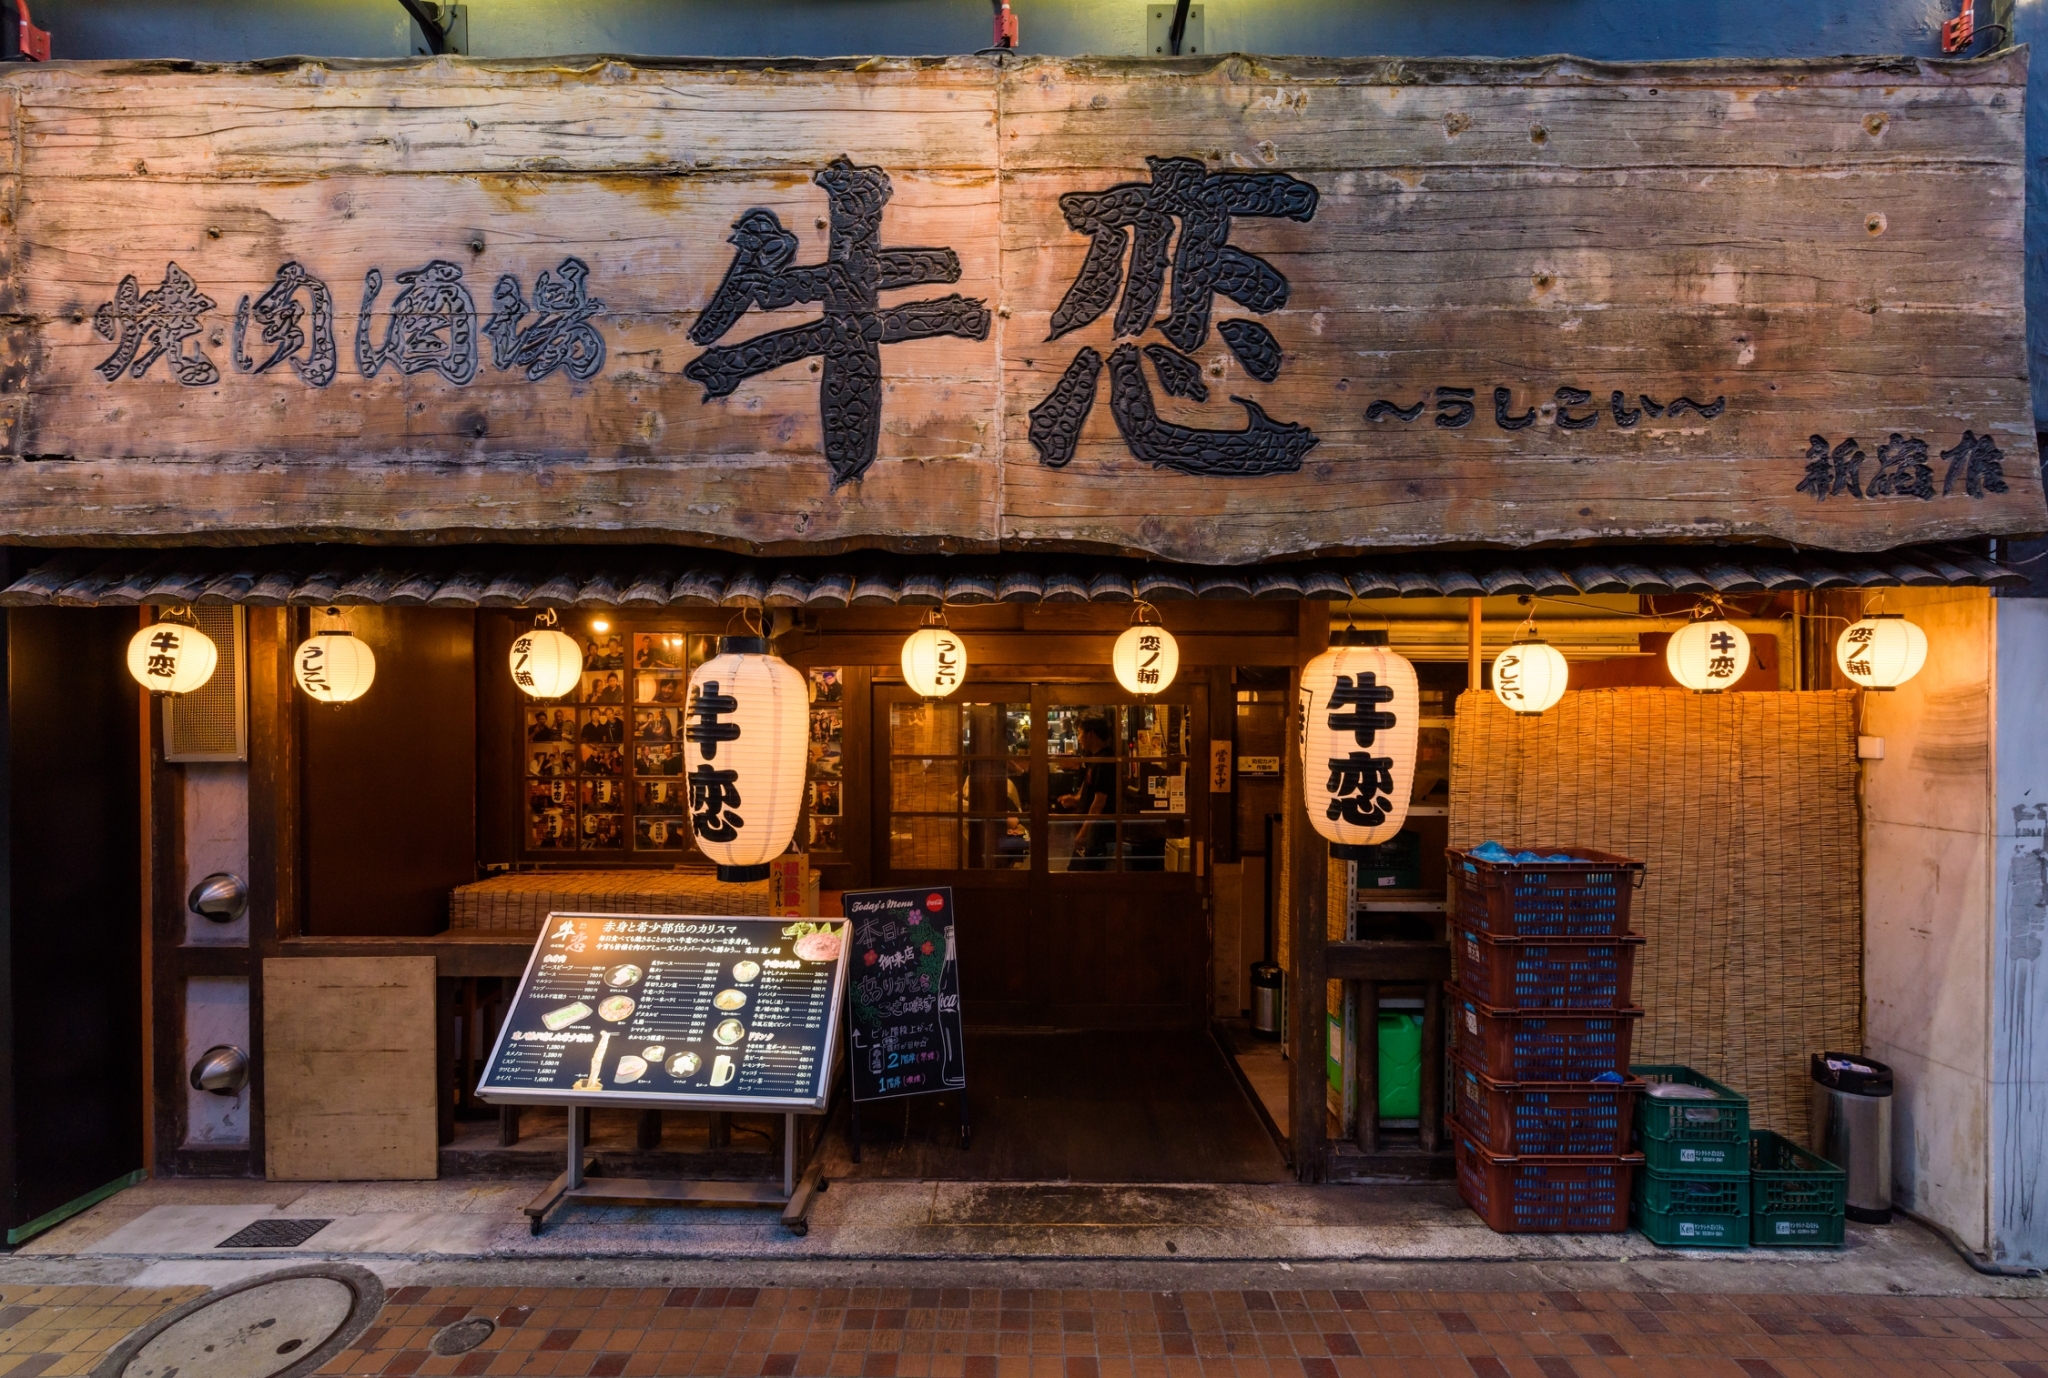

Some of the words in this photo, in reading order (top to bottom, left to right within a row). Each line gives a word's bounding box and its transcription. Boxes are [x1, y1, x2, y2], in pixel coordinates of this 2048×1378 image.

[95, 256, 608, 388] 焼肉酒場
[684, 153, 1320, 492] 牛恋
[147, 630, 179, 678] 牛恋
[303, 646, 331, 692] うしこい
[935, 639, 956, 686] うしこい
[1137, 634, 1161, 685] 恋ノ輔
[1707, 631, 1736, 678] 牛恋
[1500, 655, 1525, 700] うしこい
[686, 680, 744, 843] 牛恋
[1214, 749, 1228, 788] 営業中
[1326, 671, 1397, 827] 牛恋
[602, 920, 738, 935] 赤身と希少部位のカリスマ
[851, 899, 886, 913] Today's
[886, 898, 914, 909] Menu
[855, 918, 908, 948] 本日は
[877, 945, 915, 971] 御来店
[857, 972, 932, 1006] ありがとう
[877, 994, 937, 1018] ございます
[1681, 1150, 1694, 1160] Ken
[1681, 1224, 1694, 1234] Ken
